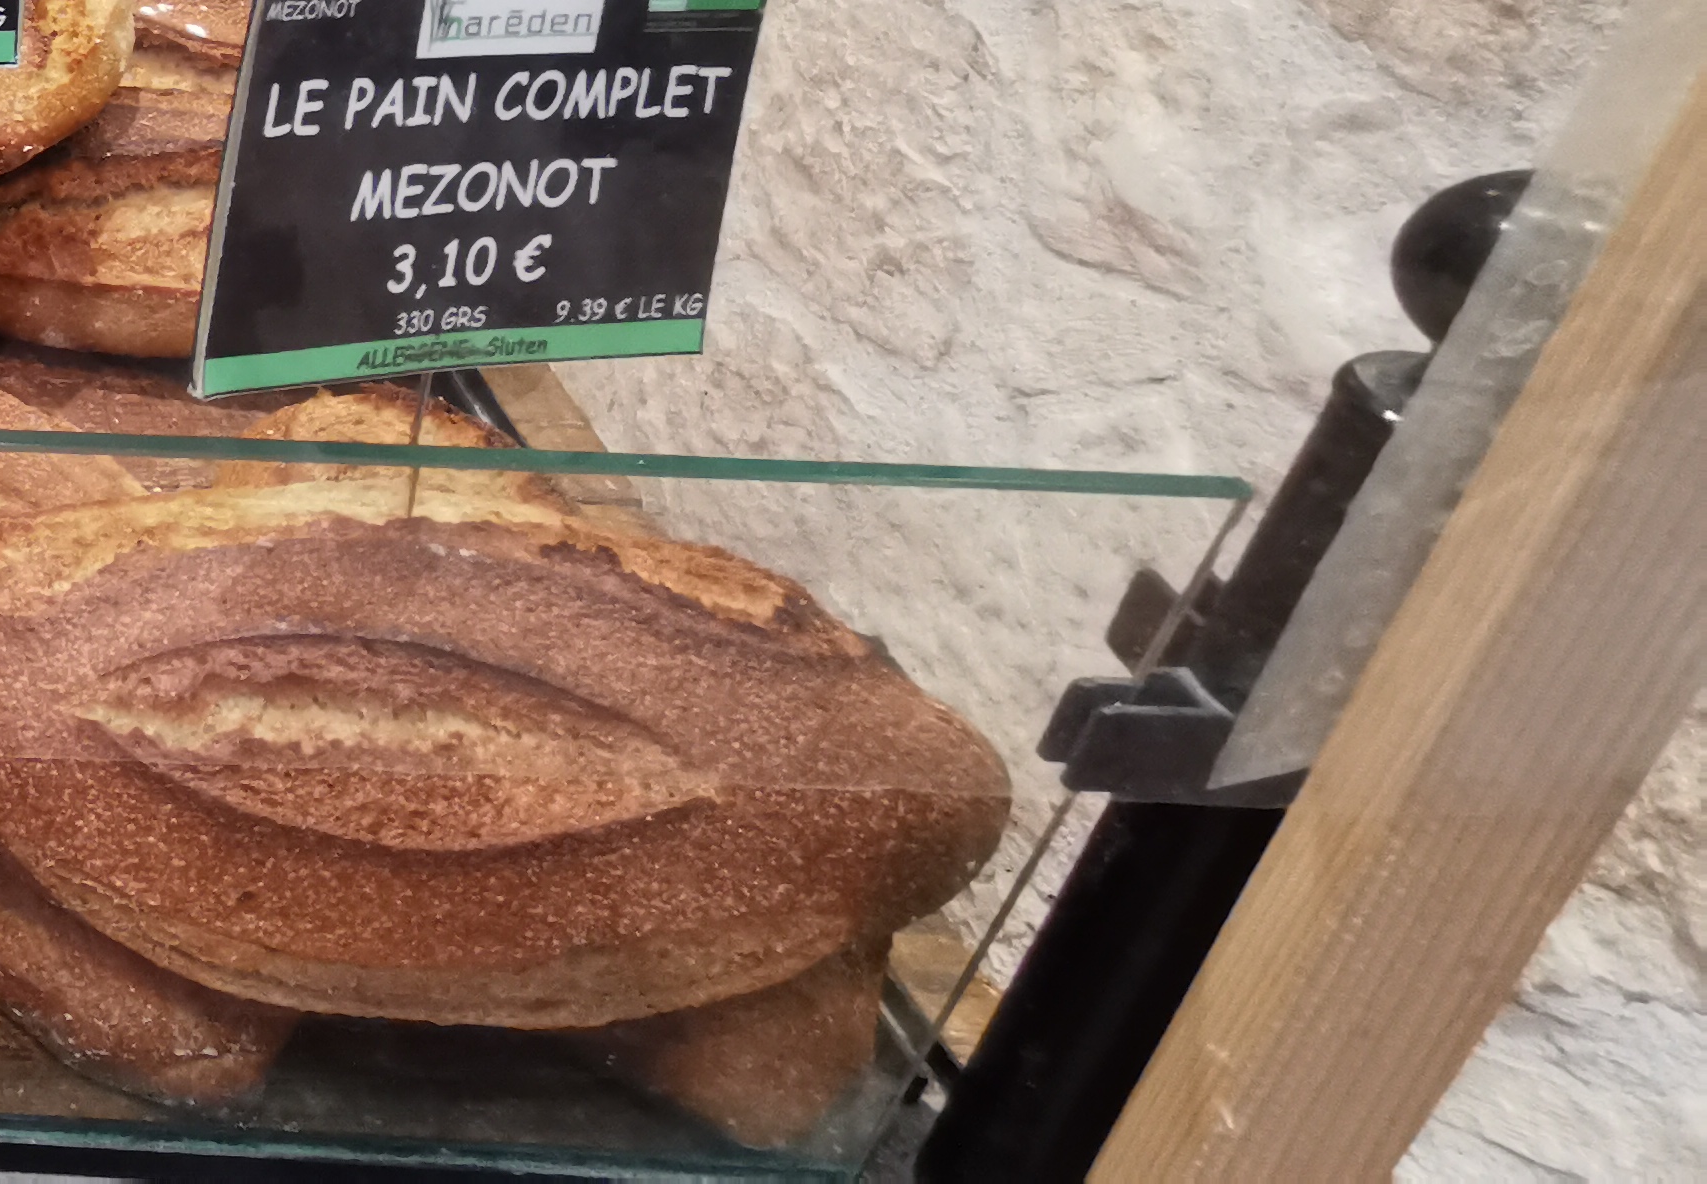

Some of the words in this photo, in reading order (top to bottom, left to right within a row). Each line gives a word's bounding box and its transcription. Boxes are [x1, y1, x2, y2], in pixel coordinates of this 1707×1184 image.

[263, 79, 328, 139] LE
[345, 72, 476, 131] PAIN
[495, 65, 732, 122] COMPLET
[350, 158, 617, 222] MEZONOT
[386, 236, 498, 300] 3,10
[512, 233, 553, 282] €
[393, 310, 435, 335] 330
[441, 307, 487, 330] GRS
[555, 298, 607, 324] 9.39
[615, 297, 633, 320] €
[638, 295, 666, 319] LE
[673, 294, 704, 315] KG
